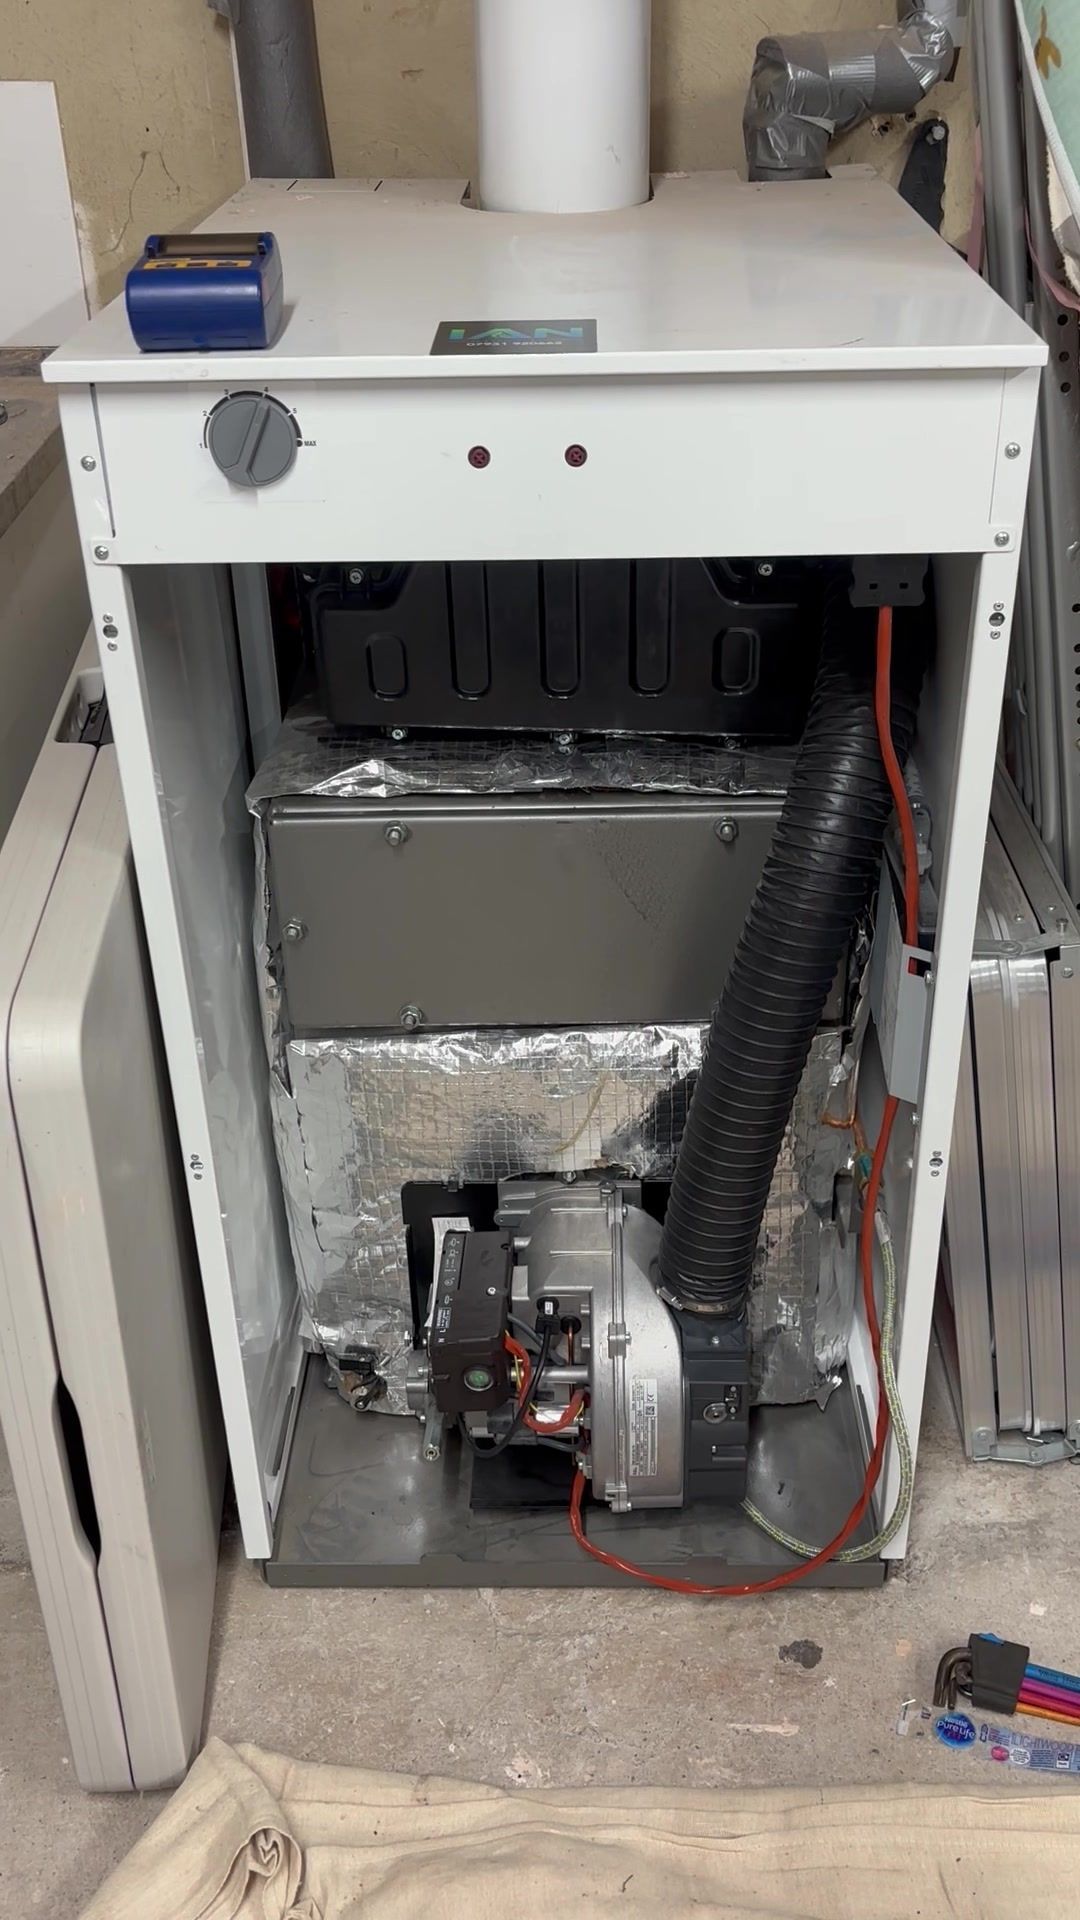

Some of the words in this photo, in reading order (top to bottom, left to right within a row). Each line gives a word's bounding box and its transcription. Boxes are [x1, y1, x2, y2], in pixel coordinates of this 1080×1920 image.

[449, 328, 583, 341] IAN
[937, 1720, 960, 1732] Pure
[959, 1727, 976, 1739] Life
